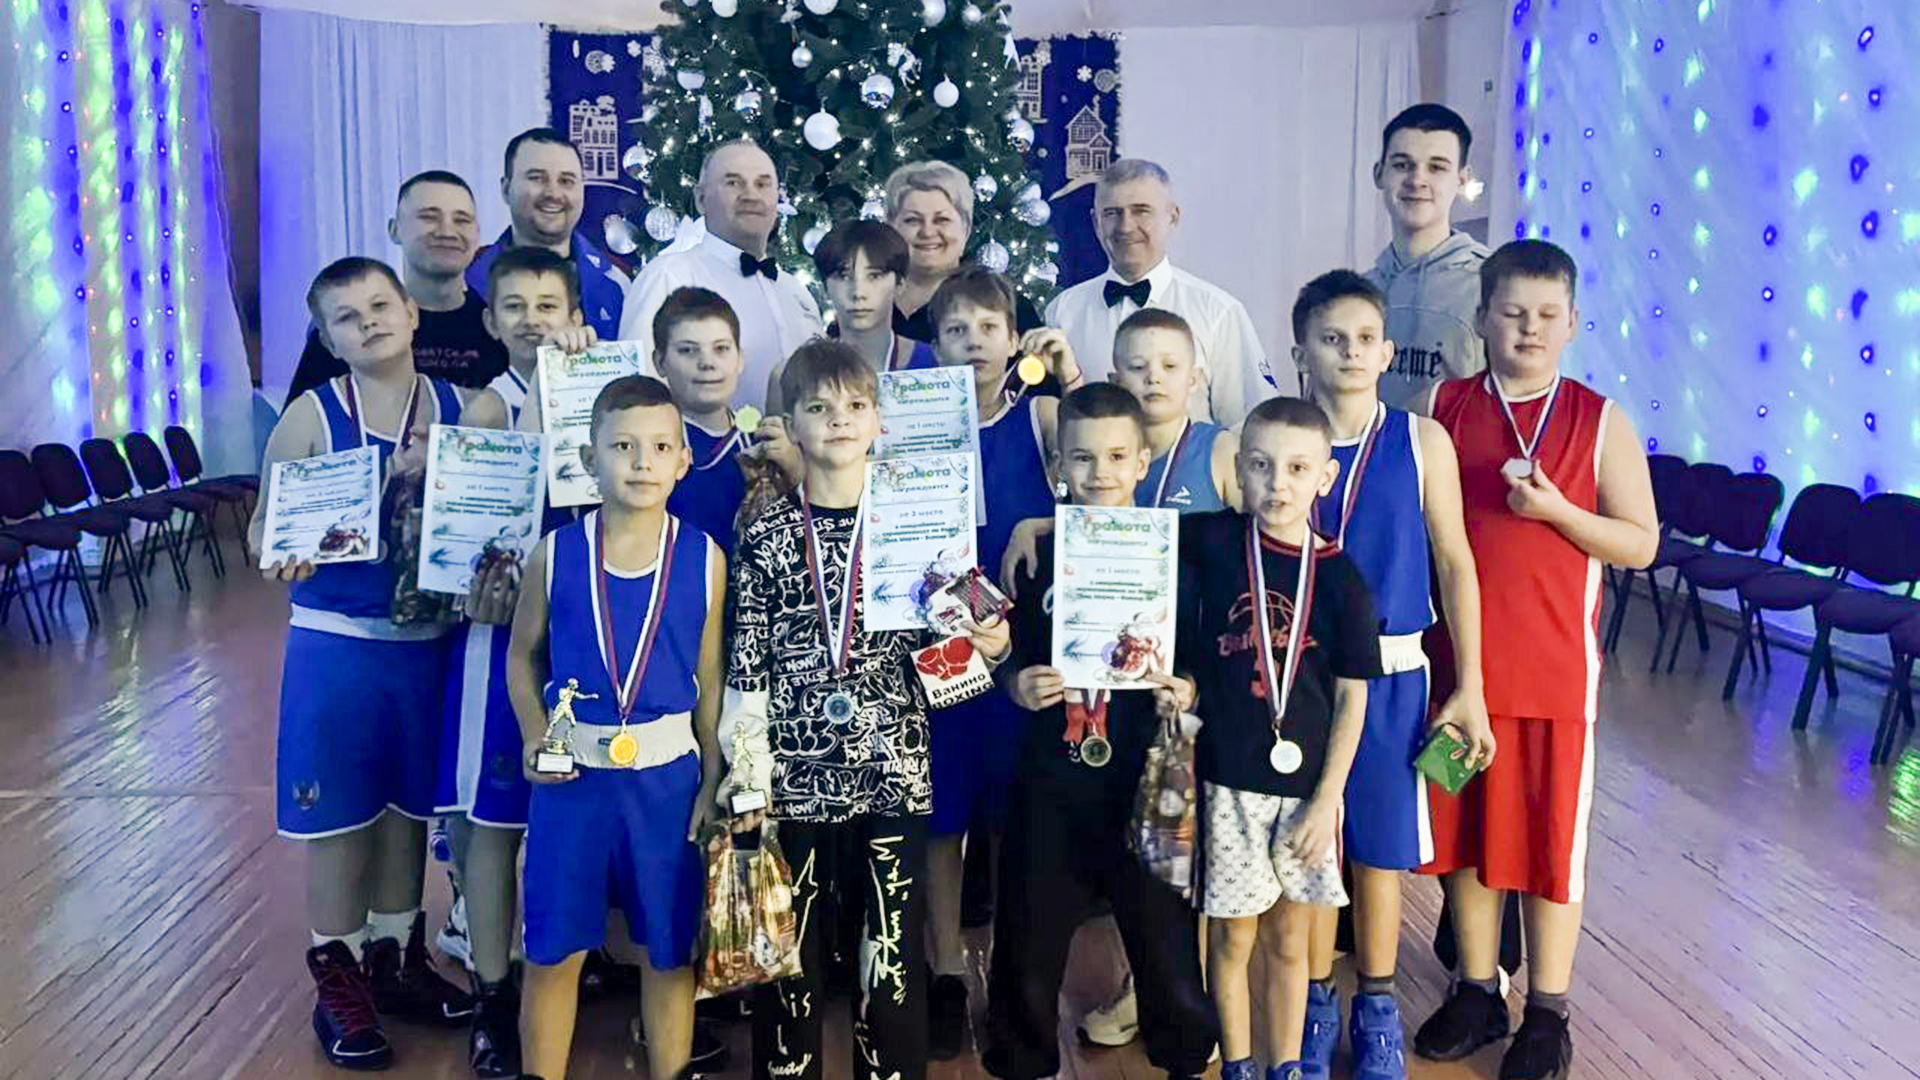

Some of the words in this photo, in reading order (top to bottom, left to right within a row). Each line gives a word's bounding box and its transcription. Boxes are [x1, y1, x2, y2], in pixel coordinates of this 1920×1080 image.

[1083, 520, 1151, 535] Грамота
[790, 671, 829, 687] STYLE
[932, 673, 986, 699] Ванино
